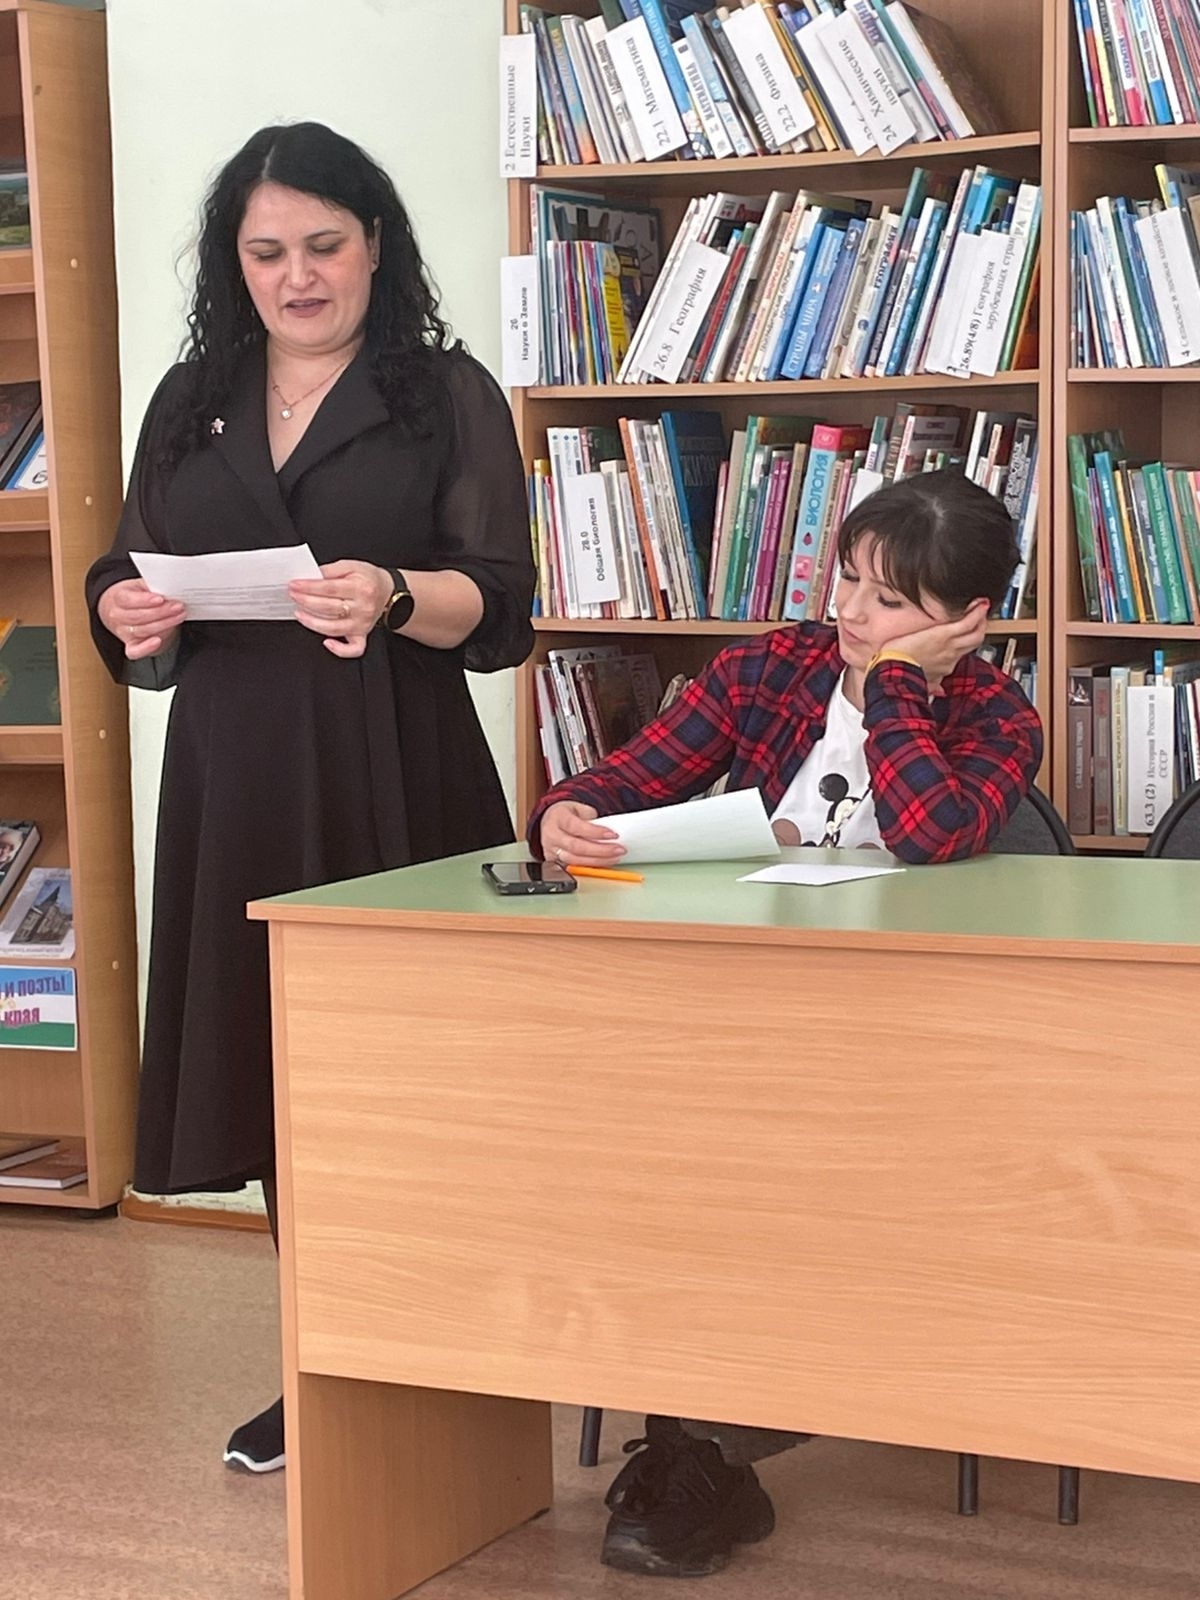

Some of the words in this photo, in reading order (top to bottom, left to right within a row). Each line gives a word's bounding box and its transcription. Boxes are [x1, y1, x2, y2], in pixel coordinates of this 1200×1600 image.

[626, 36, 659, 114] Математика
[685, 64, 714, 120] МАТЕМАТИКА
[756, 53, 781, 101] Физика
[838, 39, 883, 117] Химические
[873, 67, 898, 106] науки
[505, 64, 515, 156] Естественные
[777, 104, 797, 131] 22.2
[520, 116, 532, 157] Науки
[653, 121, 670, 145] 22.1
[882, 124, 897, 142] 24
[875, 225, 898, 289] ГЕОГРАФИЯ
[520, 287, 528, 318] Земле
[974, 260, 995, 316] География
[986, 268, 1009, 330] зарубежных
[1001, 236, 1017, 266] стран
[510, 318, 518, 329] 26
[653, 342, 672, 370] 26.8
[670, 266, 707, 335] География
[789, 330, 809, 372] СТРАНЫ
[800, 297, 818, 327] МИРА
[521, 330, 529, 360] Науки
[805, 454, 830, 527] БИОЛОГИЯ
[589, 497, 599, 545] биология
[580, 532, 591, 551] 28.0
[595, 547, 605, 581] Общая
[1147, 706, 1155, 735] России
[1147, 739, 1158, 778] История
[1159, 749, 1168, 777] СССР
[1145, 783, 1156, 799] (2)
[1145, 803, 1154, 826] 63.3
[4, 1007, 40, 1026] края
